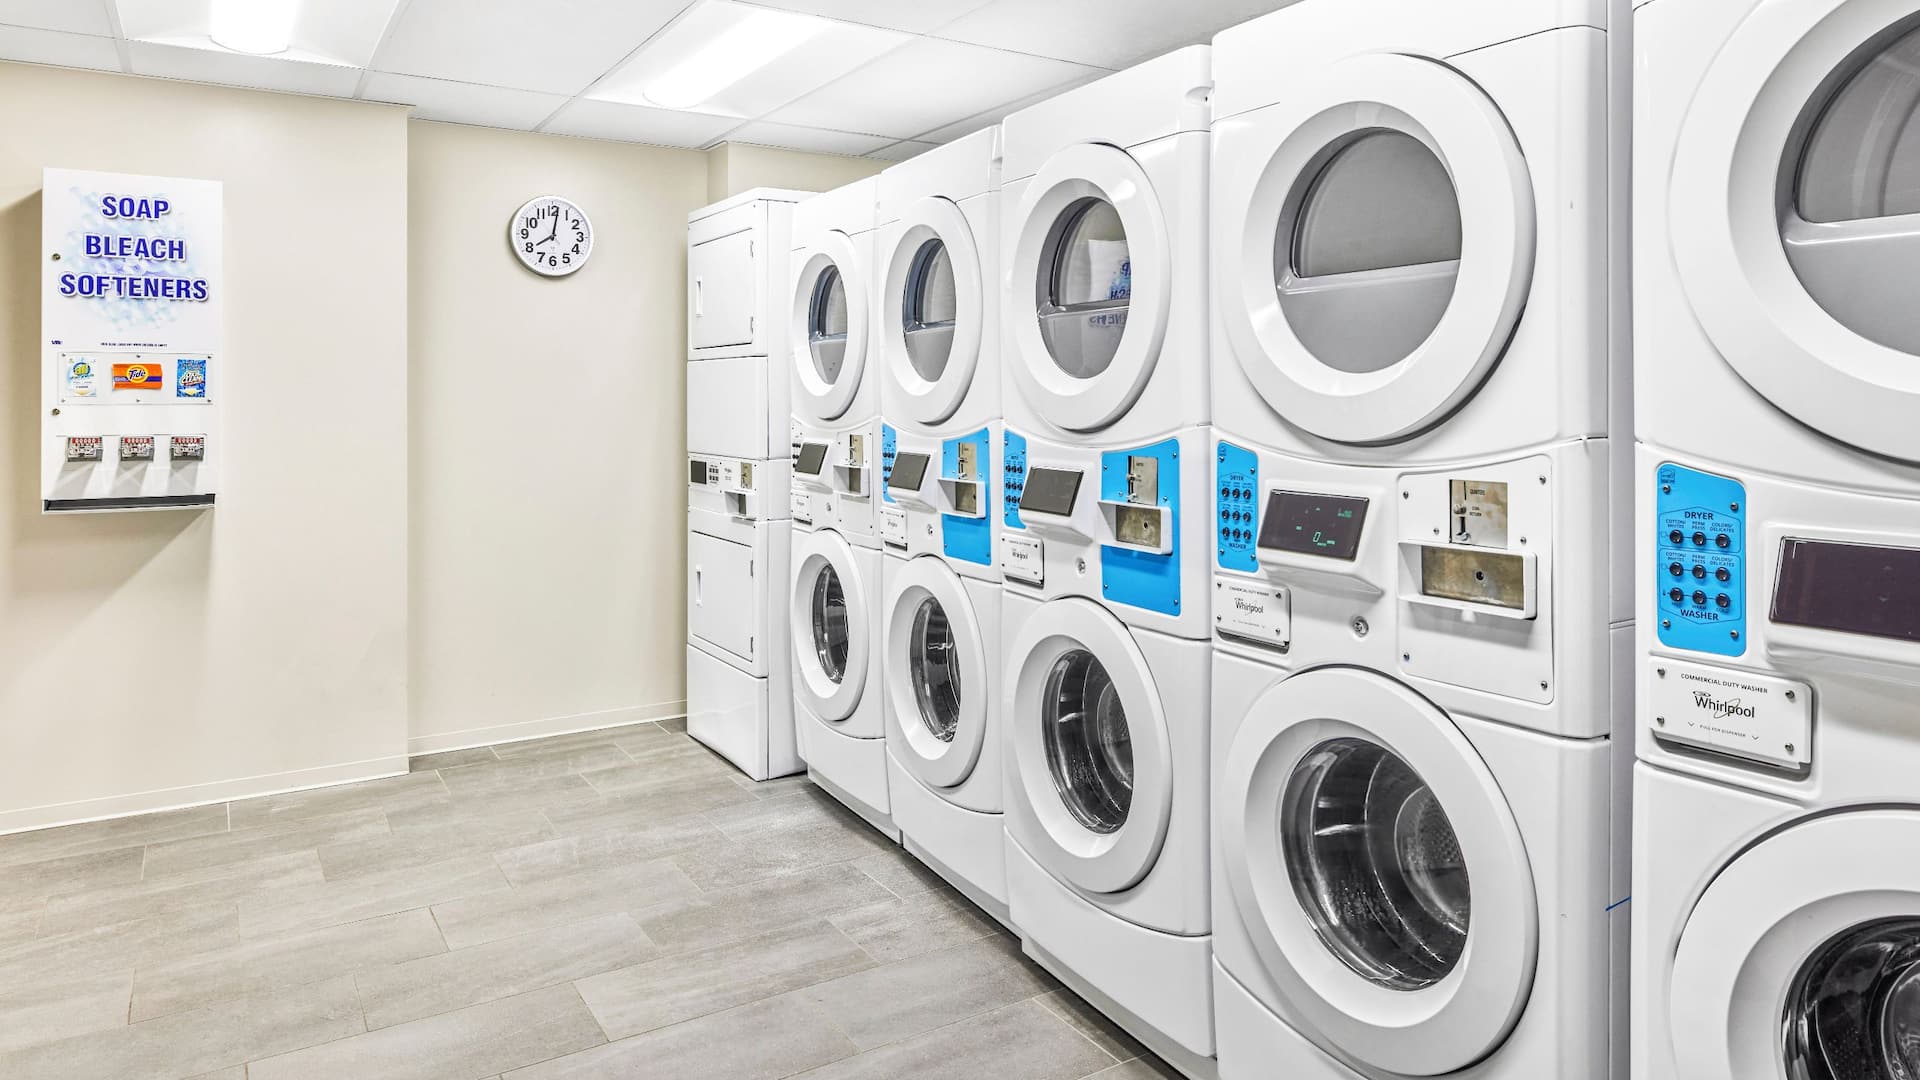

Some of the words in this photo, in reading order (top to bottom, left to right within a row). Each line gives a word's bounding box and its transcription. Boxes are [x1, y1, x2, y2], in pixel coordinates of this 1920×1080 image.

[102, 195, 170, 219] SOAP
[547, 205, 560, 217] 12
[536, 207, 545, 220] 11
[565, 209, 569, 221] 1
[526, 216, 538, 229] 10
[571, 219, 580, 230] 2
[520, 228, 529, 240] 9
[576, 231, 584, 243] 3
[85, 234, 185, 260] BLEACH
[525, 242, 534, 253] 8
[571, 243, 580, 255] 4
[536, 252, 546, 263] 7
[548, 255, 557, 267] 6
[562, 253, 571, 264] 5
[60, 273, 208, 300] SOFTENERS
[74, 363, 91, 376] all
[129, 369, 146, 380] Tide
[1684, 511, 1714, 520] DRYER
[1235, 600, 1264, 614] Whirlpool
[1680, 609, 1719, 620] WASHER
[1680, 673, 1721, 685] COMMERCIAL
[1741, 684, 1768, 694] WASHER
[1694, 695, 1755, 718] Whirlpool
